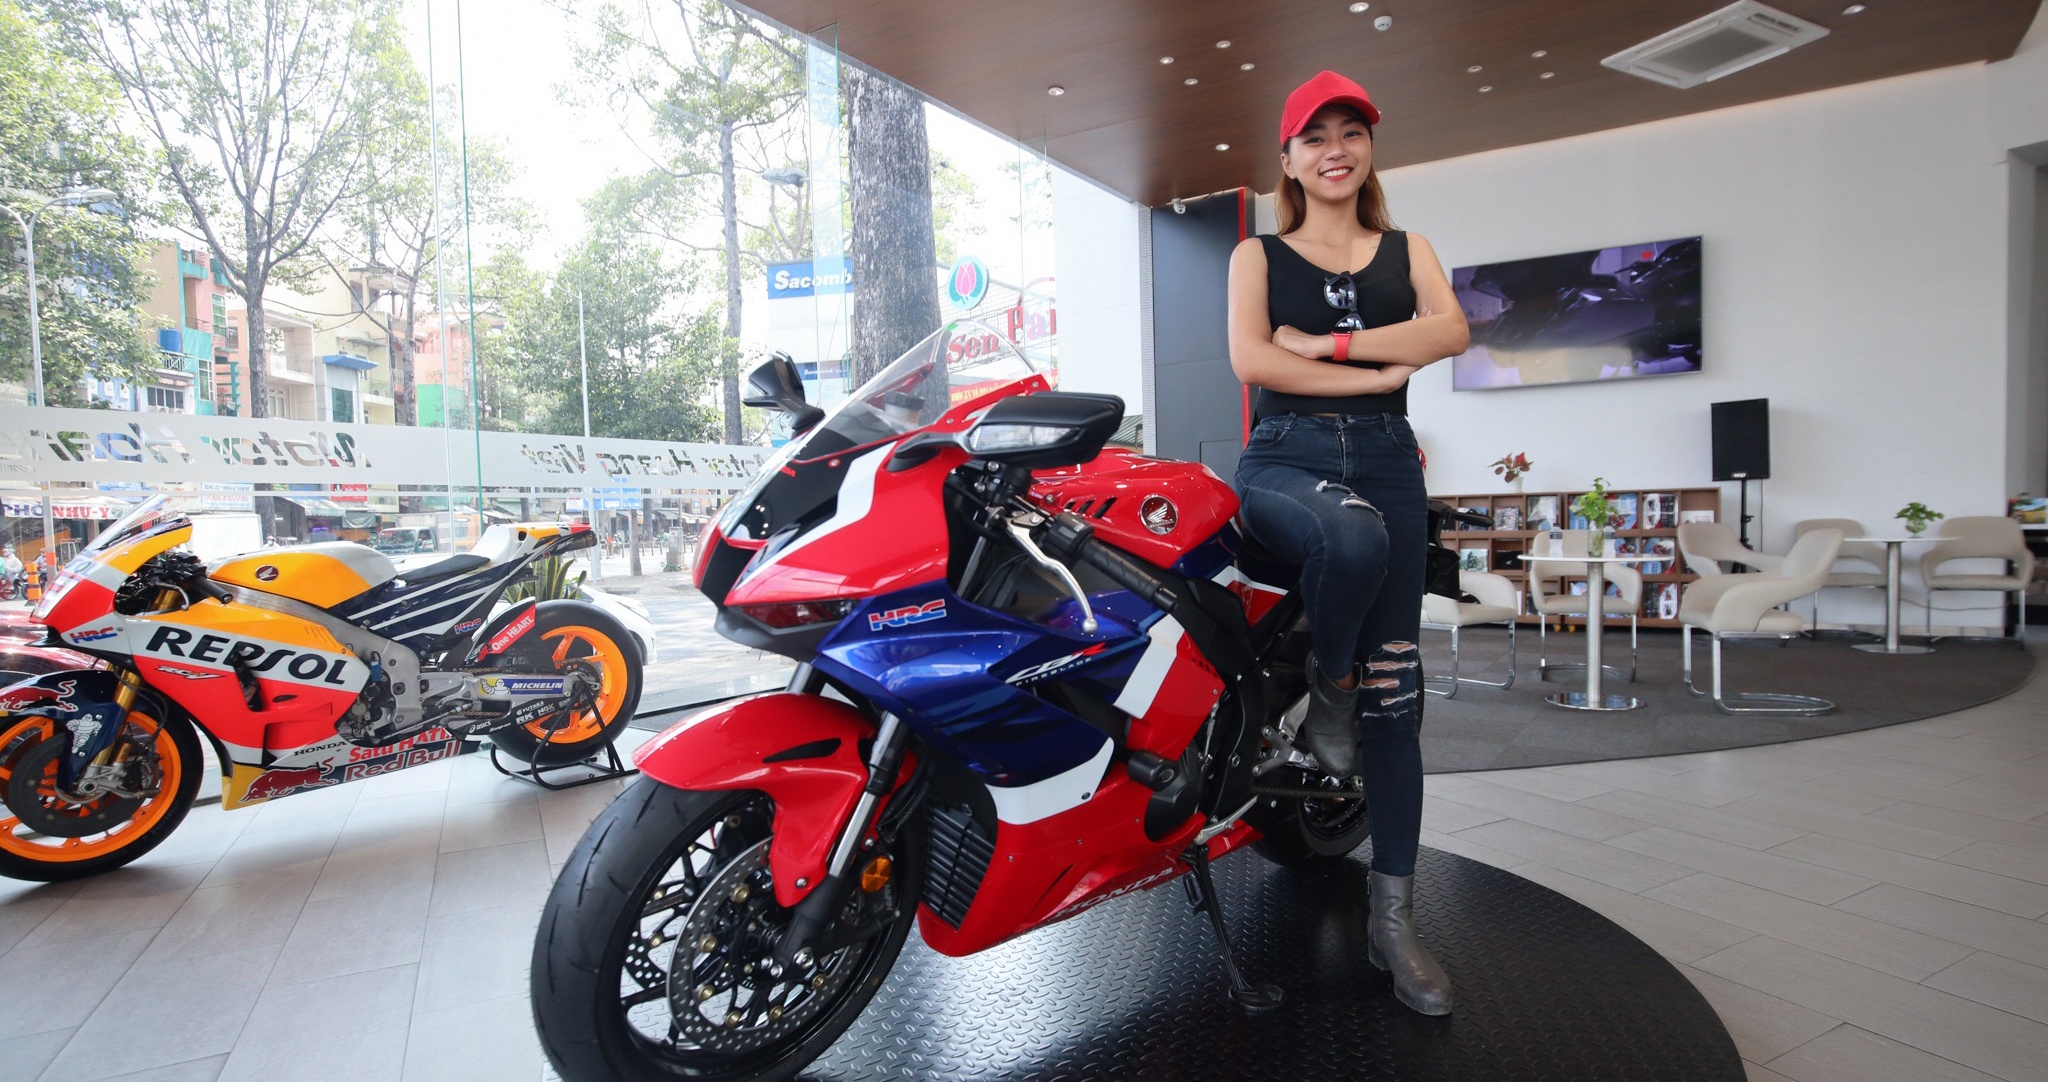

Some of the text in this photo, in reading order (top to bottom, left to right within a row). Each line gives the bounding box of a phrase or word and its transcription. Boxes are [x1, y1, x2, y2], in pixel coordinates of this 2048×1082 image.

[774, 267, 853, 291] Sacomb
[868, 598, 947, 631] HRC
[69, 626, 118, 644] HRC
[491, 635, 510, 651] One
[145, 625, 348, 685] REPSOL
[1015, 657, 1092, 686] FIREBLADE
[511, 682, 563, 690] MICHELIN
[515, 711, 535, 726] RK
[293, 741, 348, 757] HONDA
[348, 744, 393, 763] Satu
[342, 740, 463, 784] Red Bull
